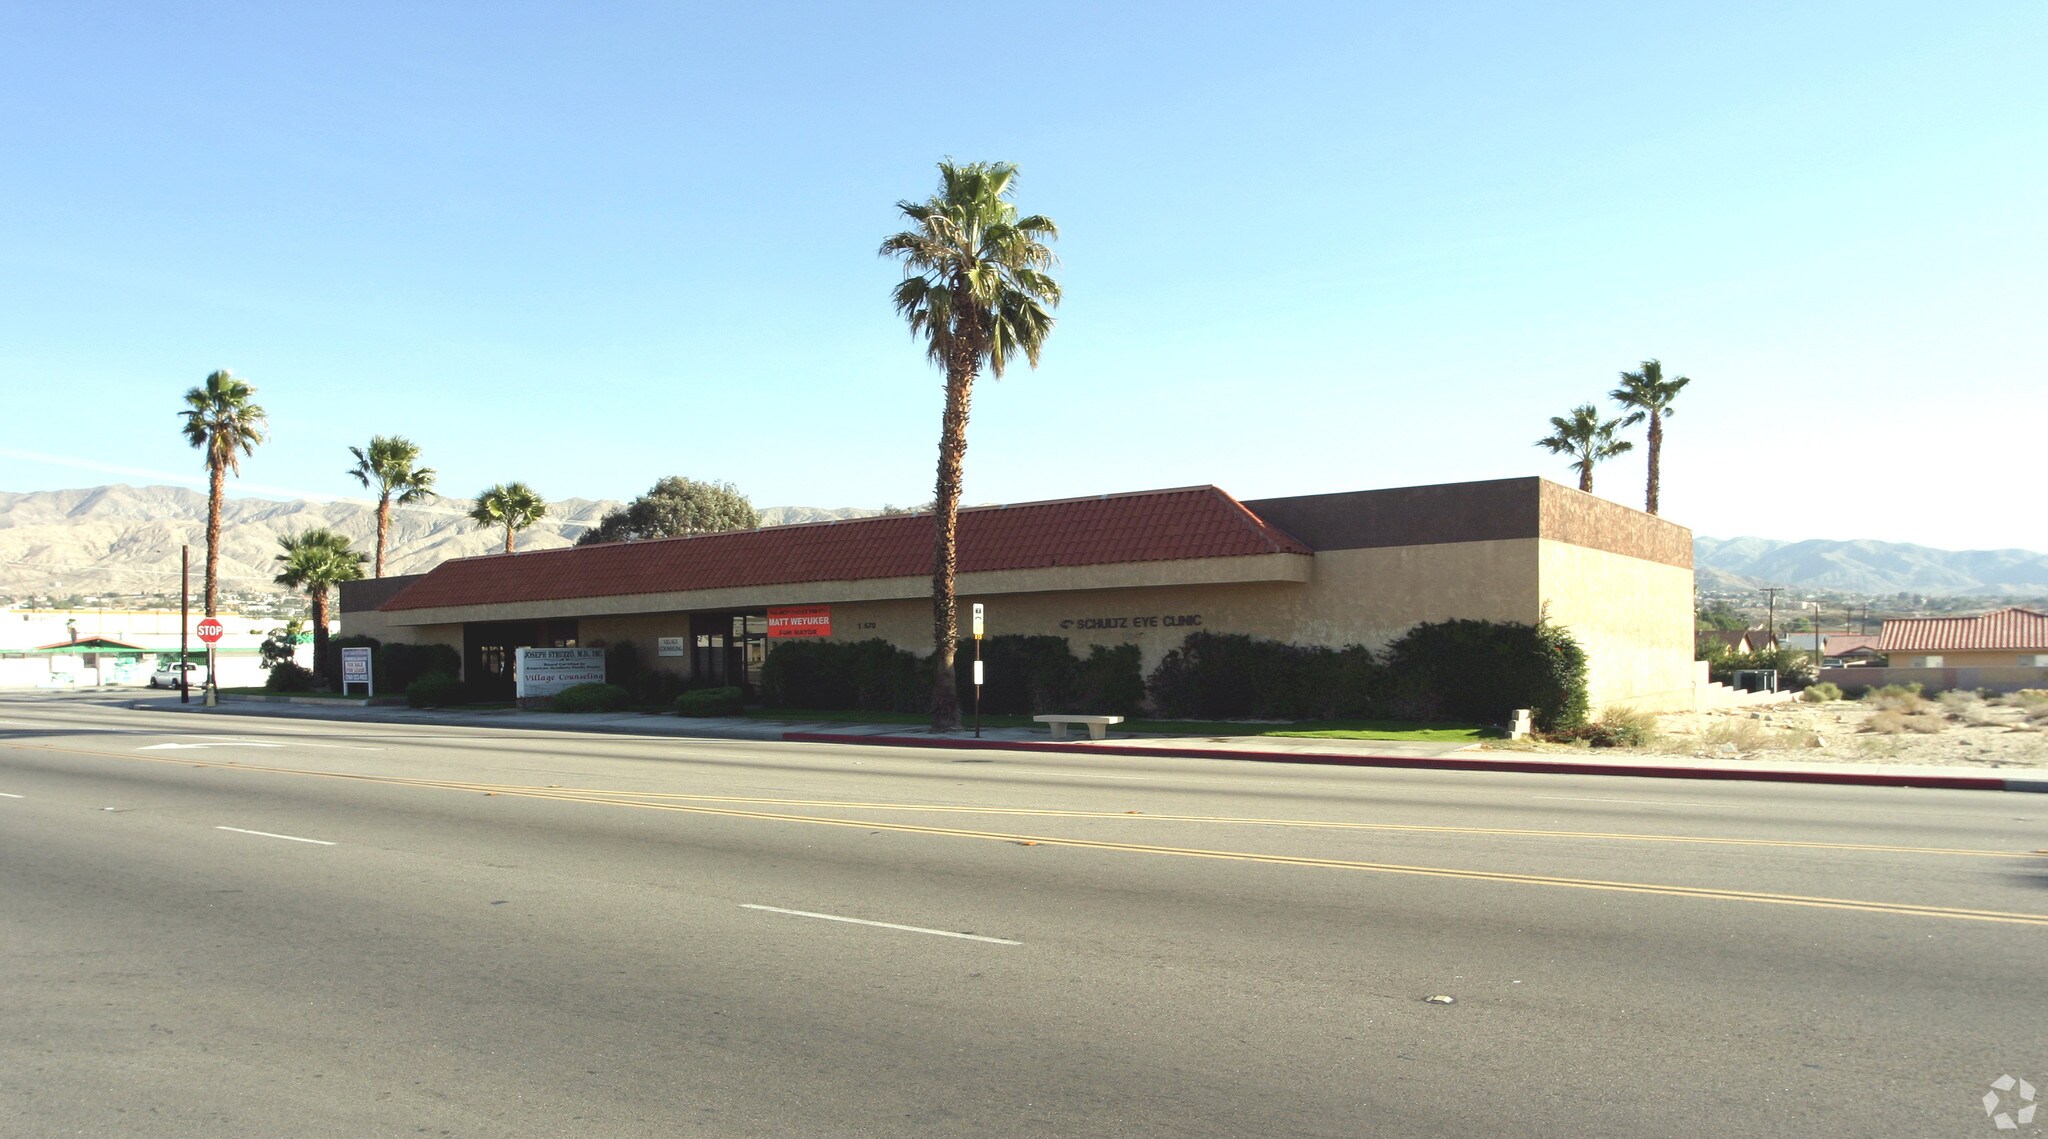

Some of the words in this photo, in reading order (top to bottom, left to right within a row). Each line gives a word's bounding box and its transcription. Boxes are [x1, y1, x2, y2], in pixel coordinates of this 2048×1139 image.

[769, 618, 789, 626] MATT
[790, 616, 830, 625] WEYUKER
[1077, 617, 1128, 629] SCHULTZ
[1133, 617, 1158, 628] EYE
[1162, 615, 1202, 627] CLINIC
[198, 625, 222, 636] STOP
[524, 651, 547, 659] JOSEPH
[525, 673, 556, 684] Village
[558, 671, 604, 682] Counseling
